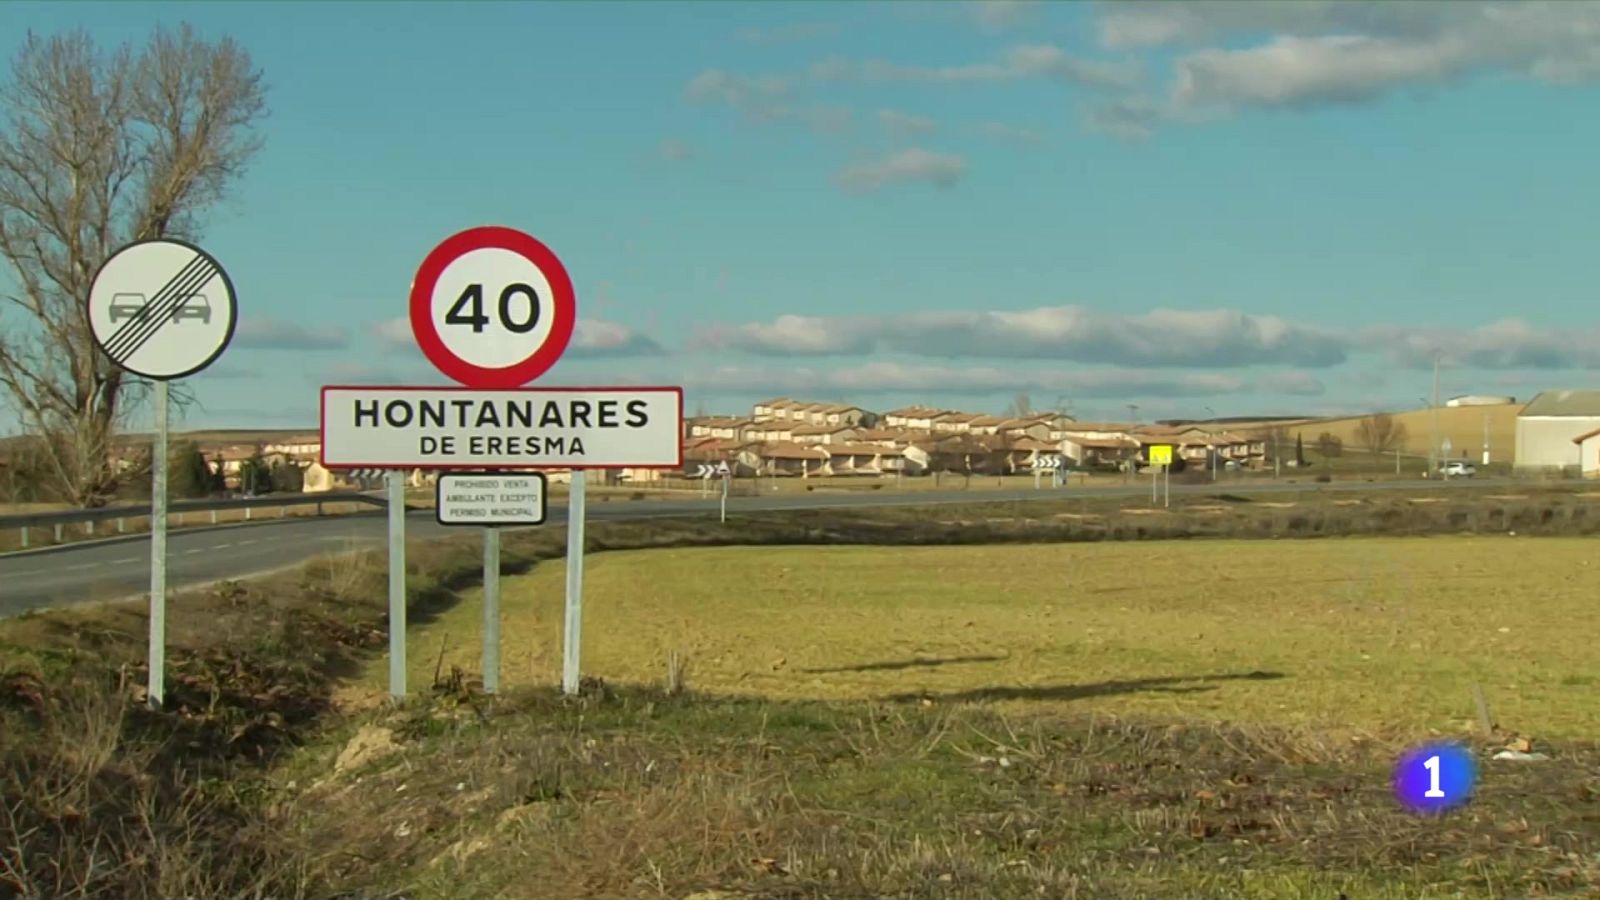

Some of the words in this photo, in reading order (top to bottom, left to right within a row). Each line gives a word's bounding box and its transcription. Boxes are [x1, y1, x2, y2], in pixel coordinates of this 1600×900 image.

[445, 283, 541, 334] 40
[354, 399, 649, 428] HONTANARES
[420, 436, 456, 455] DE
[469, 436, 586, 455] ERESMA
[504, 480, 529, 489] VENTA
[446, 493, 496, 503] AMBULANTE
[500, 493, 538, 503] EXCEPTO
[449, 507, 487, 517] PERMISO
[490, 507, 534, 517] MUNICIPAL
